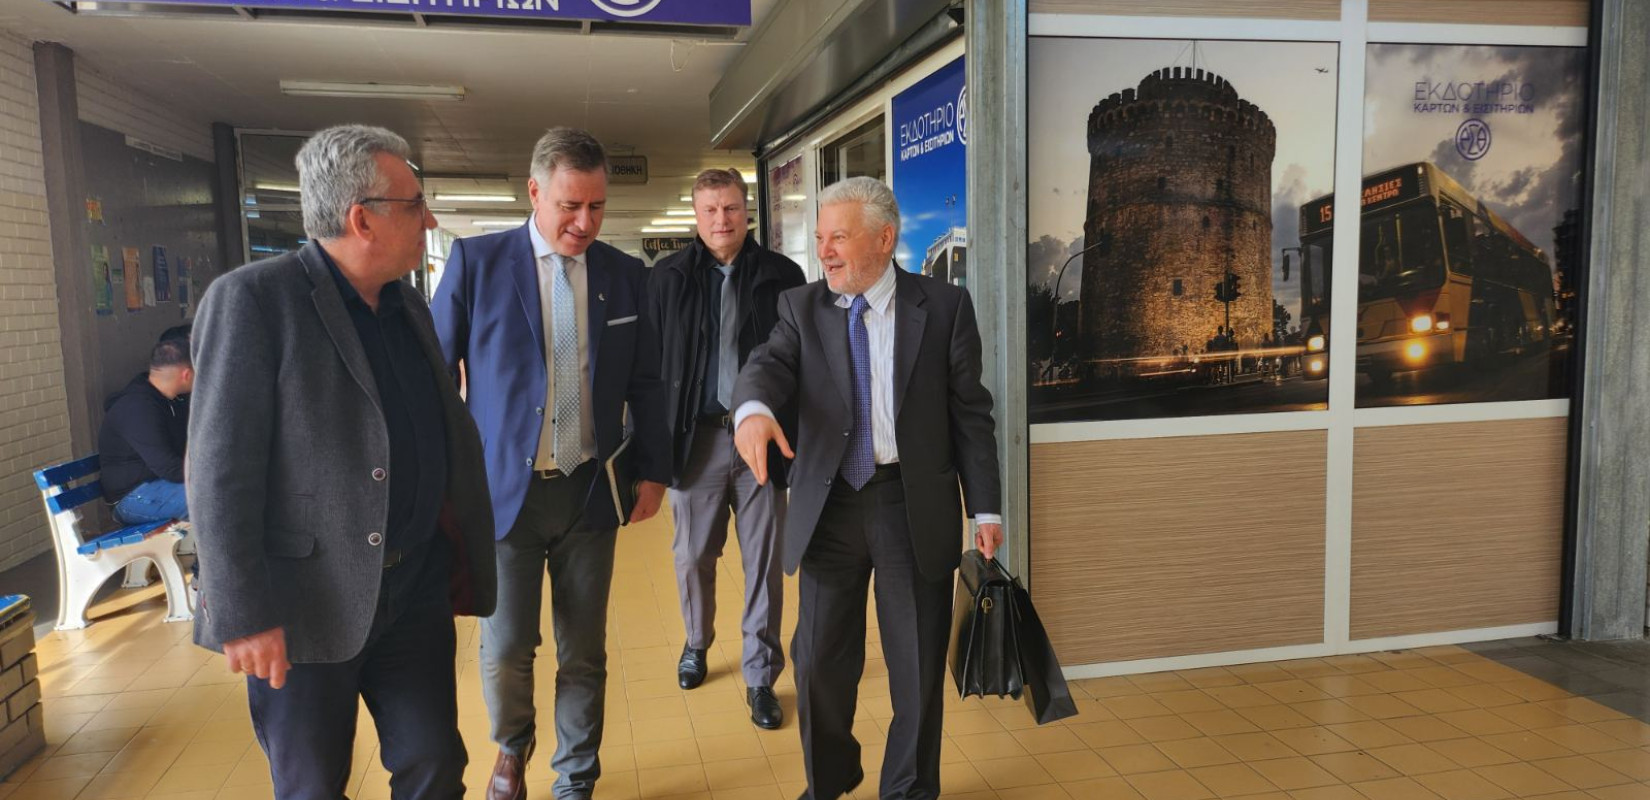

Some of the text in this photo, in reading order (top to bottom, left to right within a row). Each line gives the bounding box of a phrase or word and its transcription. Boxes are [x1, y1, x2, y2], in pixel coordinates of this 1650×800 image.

[1414, 82, 1535, 101] ΕΚΔΟΤΗΡΙΟ
[1414, 103, 1535, 114] ΚΑΡΤΩΝ & ΕΙΣΙΤΗΡΙΩΝ
[901, 102, 954, 147] ΕΚΔΟΤΗΡΙΟ
[611, 164, 642, 176] ΙΟΘΗΚΗ
[1362, 178, 1402, 198] ΛΗΣΙΕΣ
[644, 239, 669, 251] Coffee
